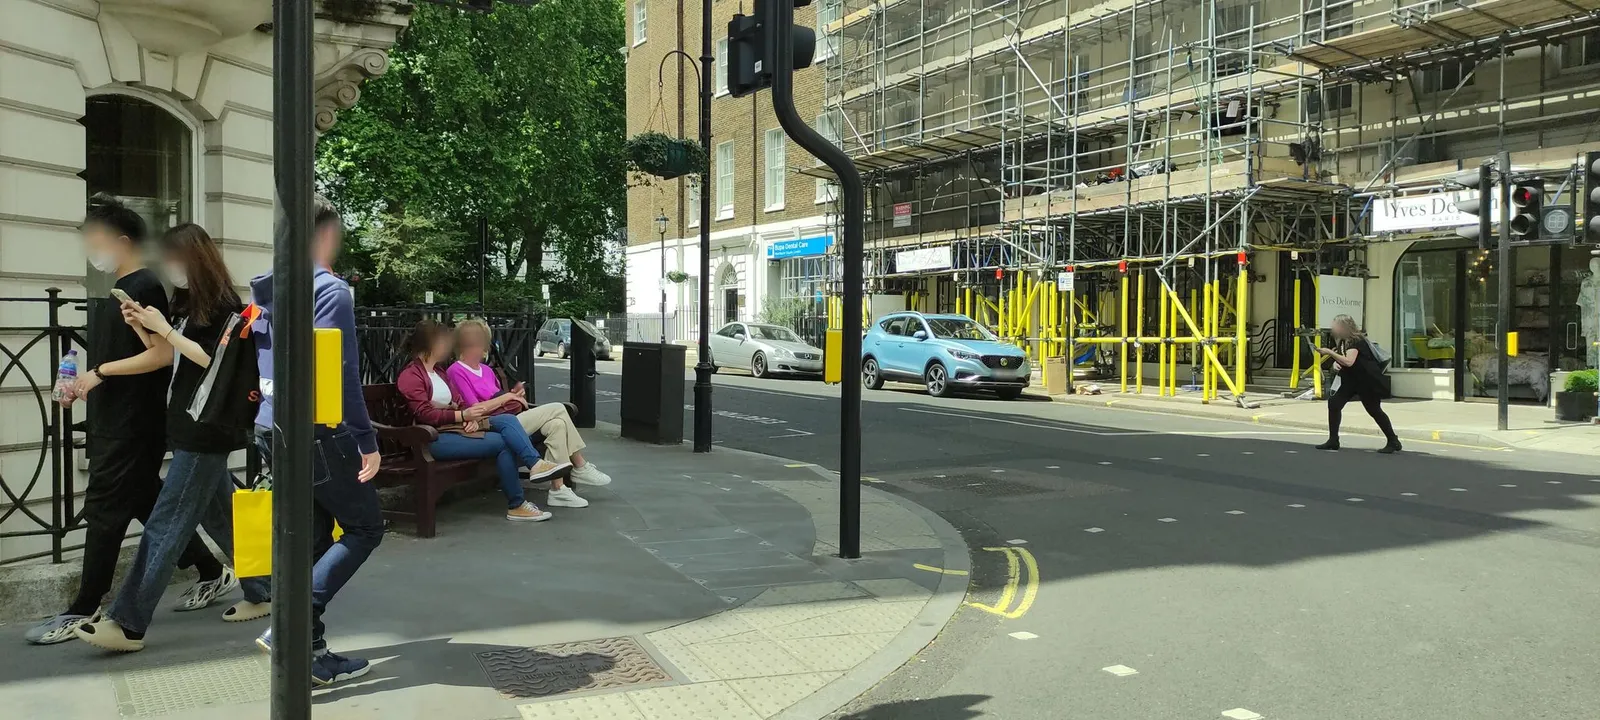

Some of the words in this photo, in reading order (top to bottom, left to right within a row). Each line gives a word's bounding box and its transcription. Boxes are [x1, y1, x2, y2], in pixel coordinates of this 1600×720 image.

[1390, 202, 1427, 218] Yves
[785, 242, 798, 250] Dental
[1336, 297, 1361, 306] Delorme
